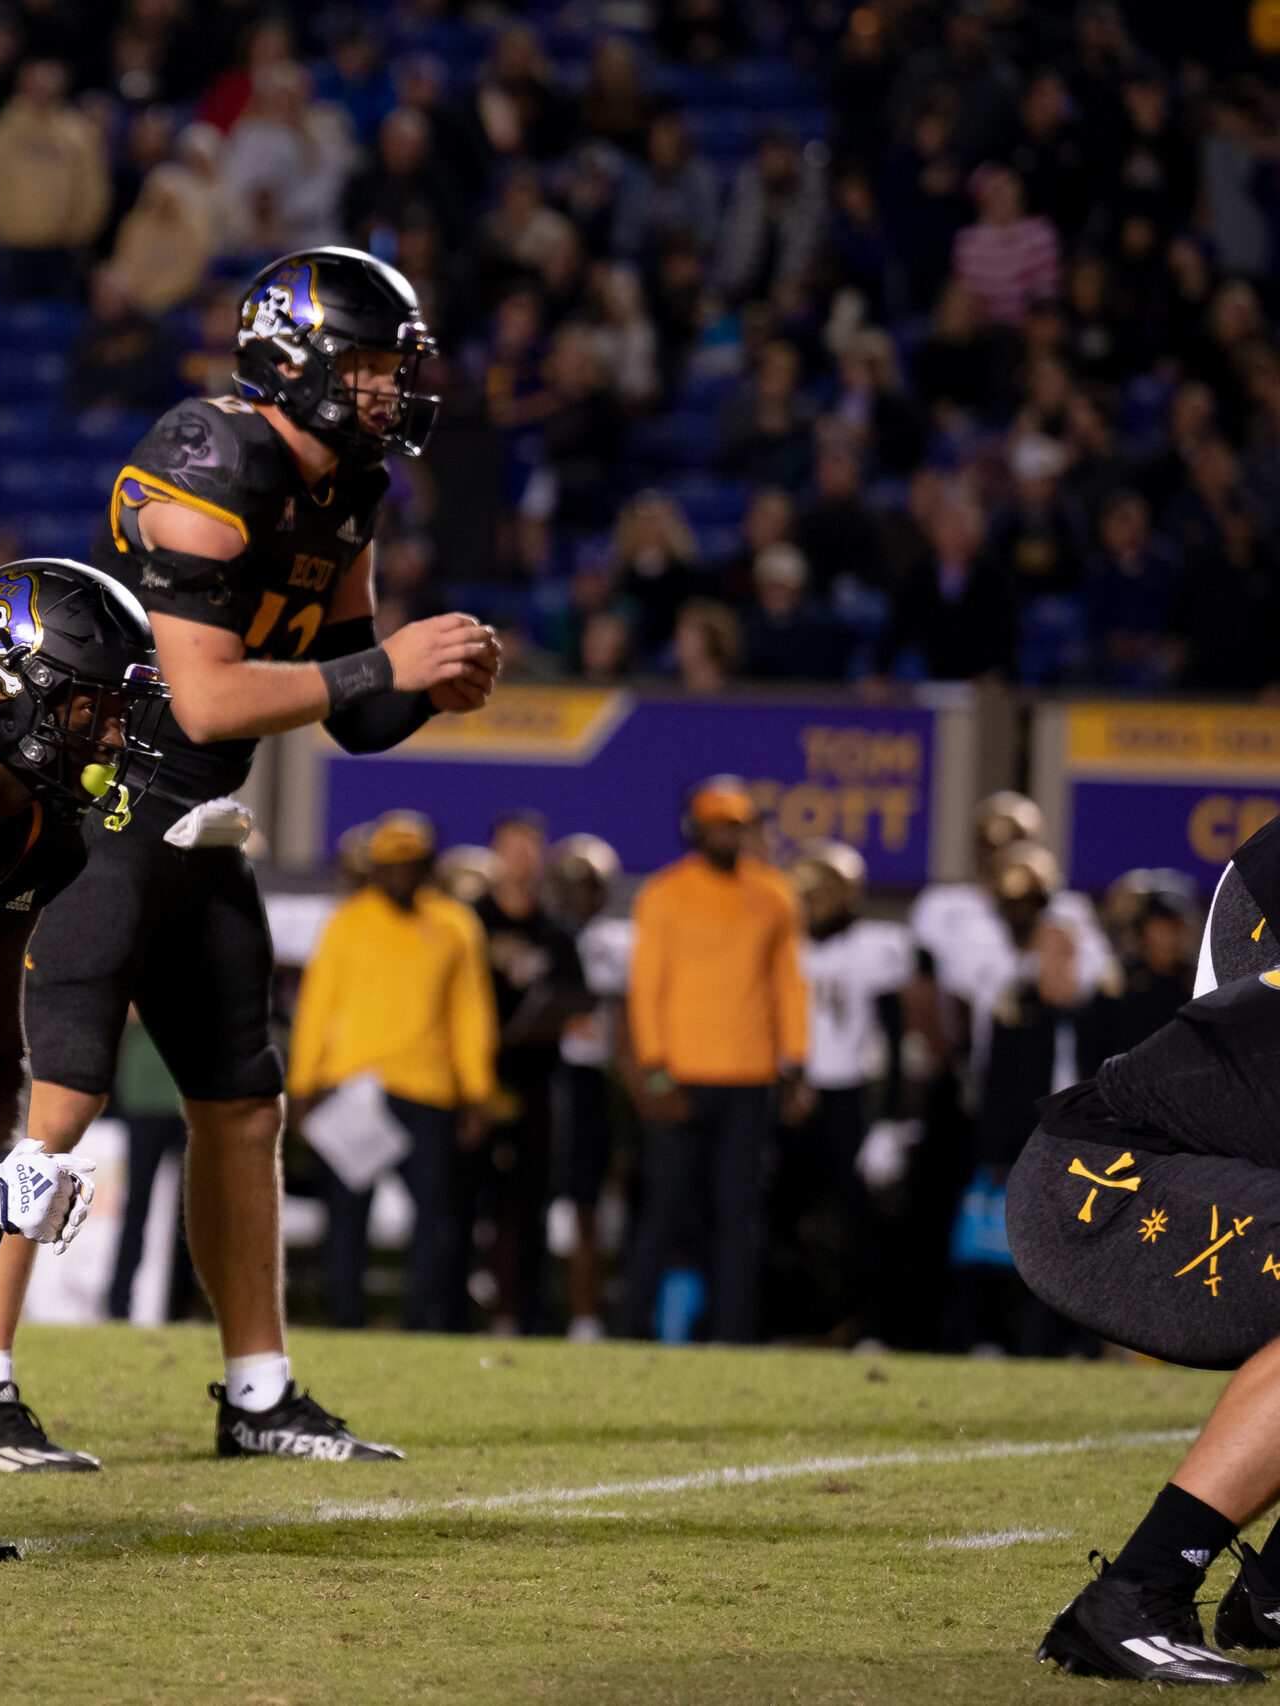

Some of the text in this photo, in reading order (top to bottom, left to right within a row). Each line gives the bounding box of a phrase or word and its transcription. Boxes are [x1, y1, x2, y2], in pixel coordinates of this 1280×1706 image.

[287, 552, 337, 592] ECU
[15, 1162, 31, 1214] adidas
[232, 1420, 354, 1462] ADIZERO
